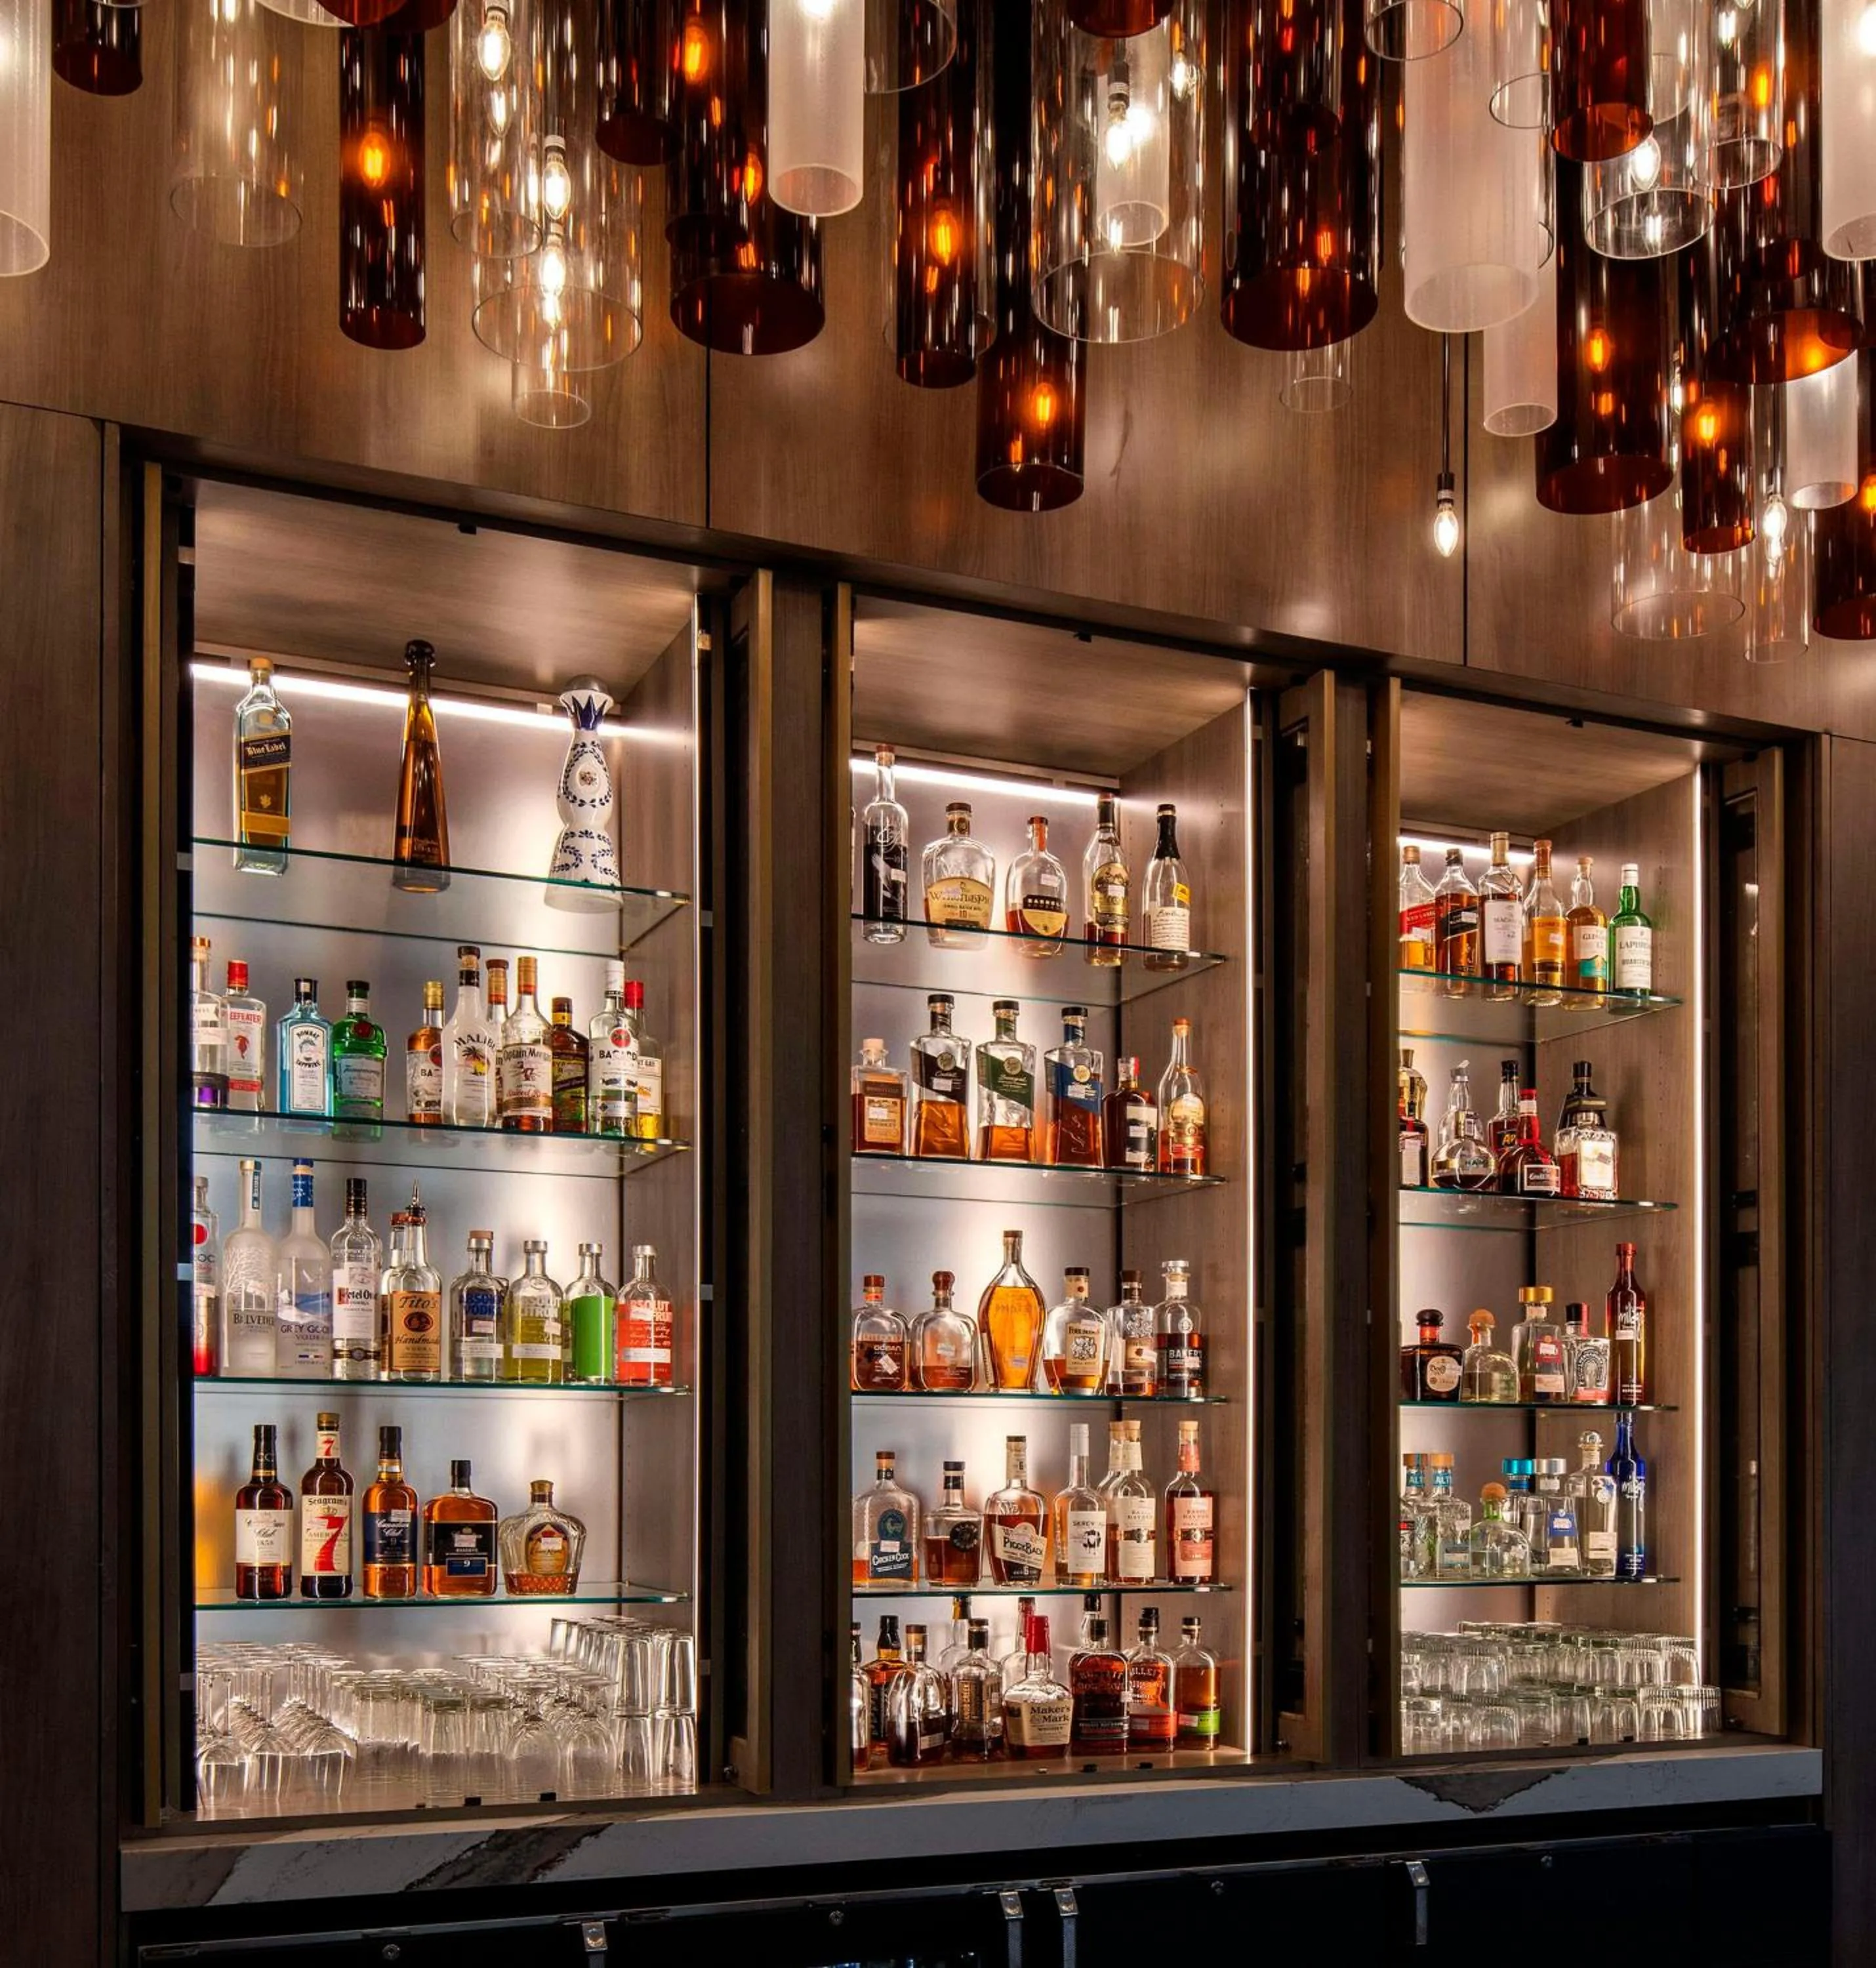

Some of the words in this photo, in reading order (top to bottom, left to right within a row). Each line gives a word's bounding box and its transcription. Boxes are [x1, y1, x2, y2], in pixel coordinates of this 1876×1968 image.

[399, 1296, 437, 1309] Tito's
[322, 1439, 335, 1457] 7
[315, 1515, 348, 1572] 7
[1030, 1705, 1071, 1715] Maker's
[1042, 1714, 1069, 1723] Mark
